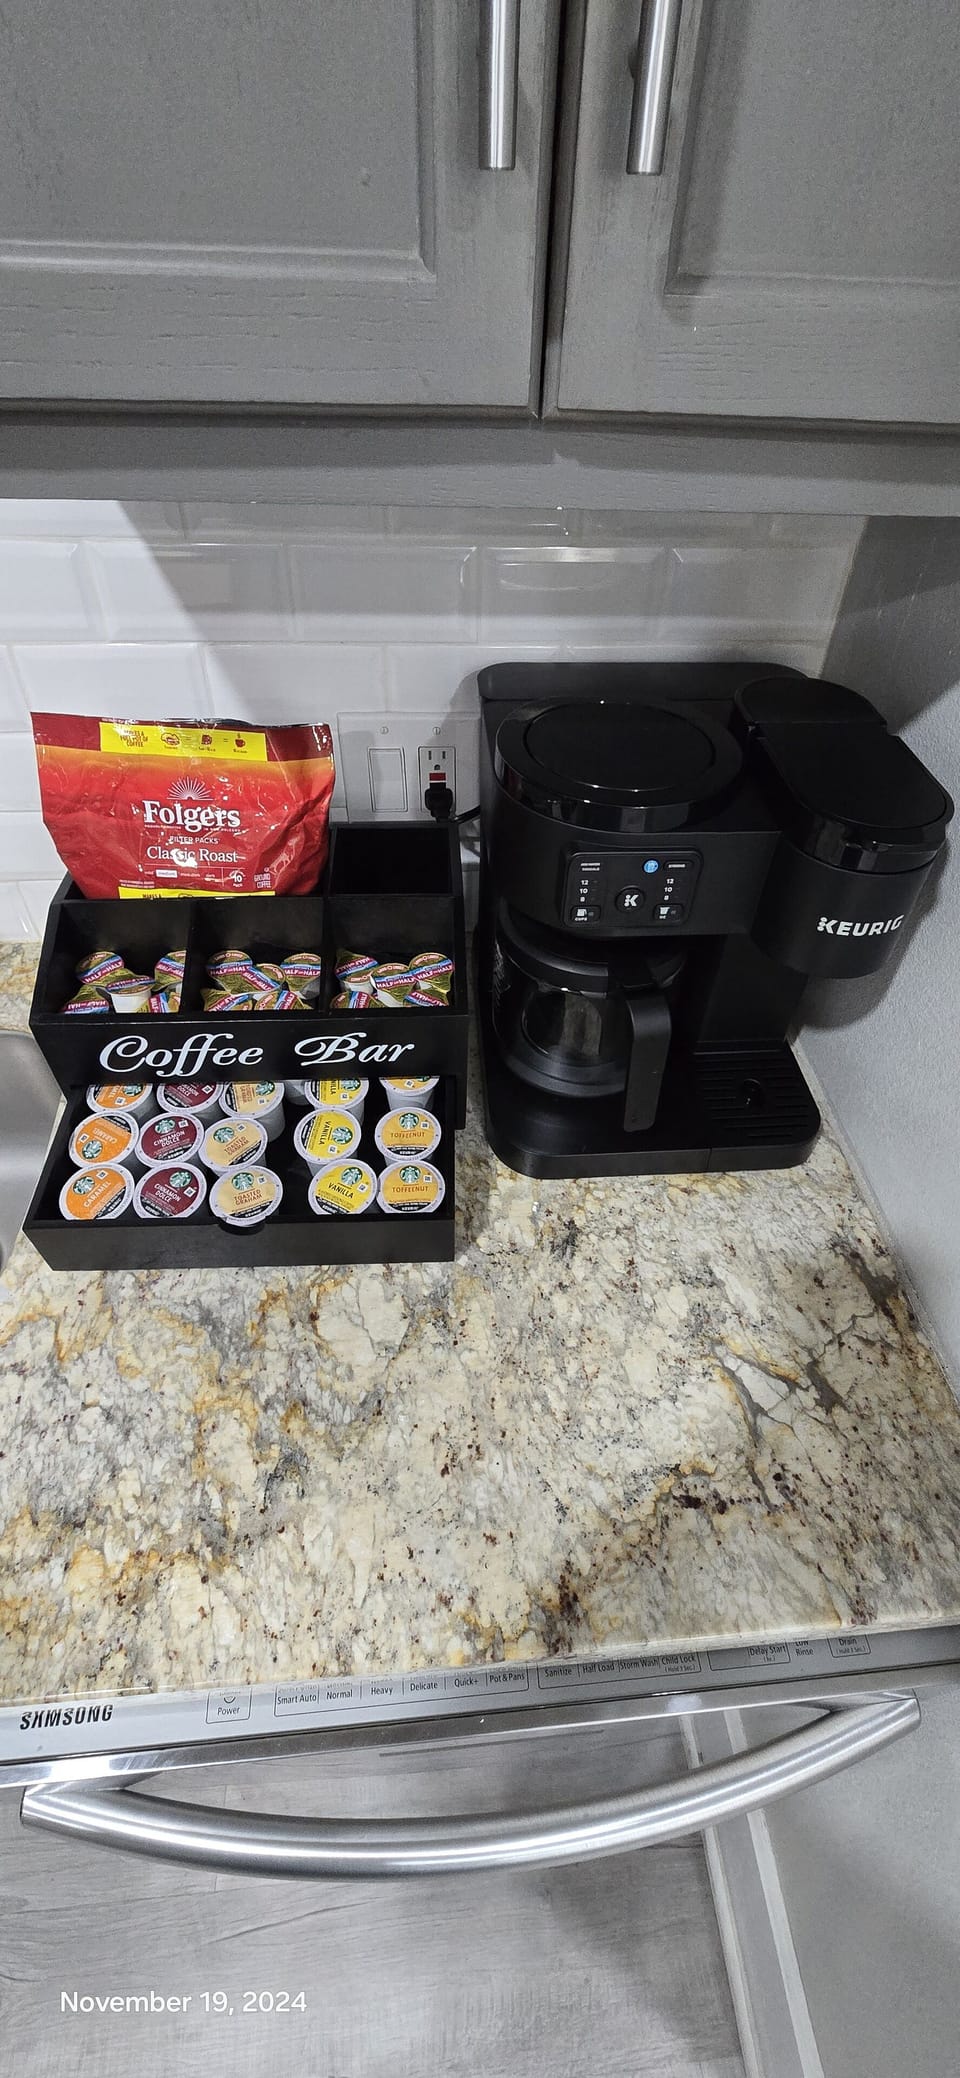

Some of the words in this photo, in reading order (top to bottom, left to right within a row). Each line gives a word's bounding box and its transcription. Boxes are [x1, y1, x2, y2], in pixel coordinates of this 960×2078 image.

[142, 800, 241, 832] Folgers
[170, 836, 193, 845] FILTER
[199, 848, 238, 863] Roast
[817, 914, 905, 937] KEURIG
[84, 971, 102, 982] HALF
[105, 960, 122, 972] HALF
[417, 970, 433, 980] HALF
[99, 1032, 264, 1078] Coffee
[294, 1032, 415, 1067] Bar
[153, 1130, 185, 1146] CINNAMON
[318, 1120, 330, 1146] VANILLA
[390, 1131, 425, 1139] TOFFEENUT
[161, 1137, 180, 1147] DOLCE
[224, 1136, 247, 1153] TOASTED
[83, 1181, 111, 1208] CARAMEL
[154, 1183, 181, 1202] CINNAMON
[233, 1189, 261, 1201] TOASTED
[328, 1182, 354, 1199] VANILLA
[392, 1185, 429, 1193] TOFFEENUT
[155, 1190, 171, 1203] DOLCE
[235, 1193, 262, 1206] GRAHAM
[838, 1637, 858, 1646] Drain
[752, 1647, 769, 1657] Delay
[769, 1645, 787, 1654] Start
[795, 1648, 814, 1656] Rinse
[619, 1661, 640, 1670] Storm
[640, 1659, 659, 1668] Wash
[661, 1656, 679, 1665] Child
[680, 1655, 696, 1663] Lock
[544, 1667, 572, 1678] Sanitize
[582, 1664, 596, 1674] Half
[598, 1662, 615, 1672] Load
[410, 1681, 438, 1692] Delicate
[454, 1678, 479, 1688] Quick+
[326, 1689, 353, 1700] Normal
[371, 1686, 394, 1696] Heavy
[277, 1696, 298, 1705] Smart
[299, 1695, 317, 1703] Auto
[20, 1704, 113, 1730] SAMSUNG
[217, 1707, 240, 1716] Power
